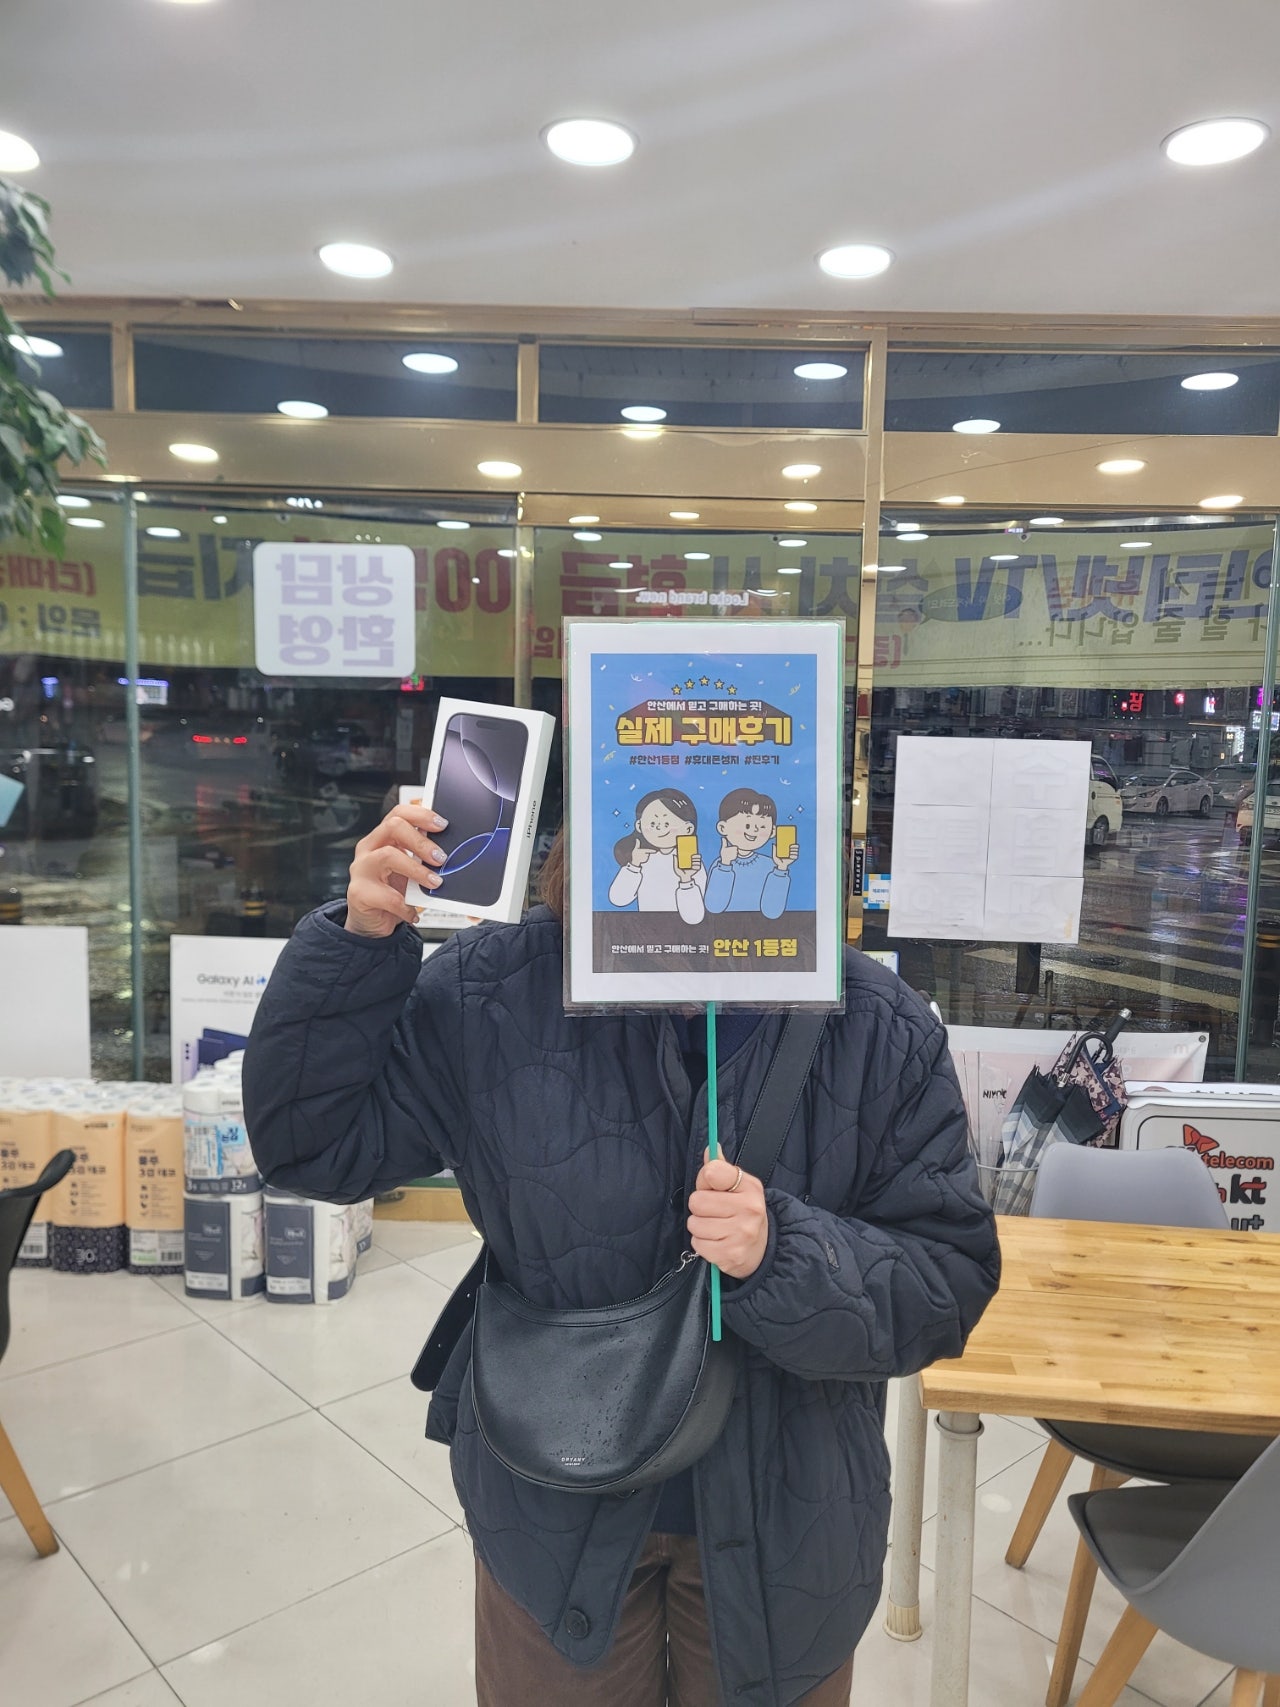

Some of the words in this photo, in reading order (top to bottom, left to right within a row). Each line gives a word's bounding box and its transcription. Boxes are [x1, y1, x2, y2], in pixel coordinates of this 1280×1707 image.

[647, 701, 686, 711] 안산에서
[688, 701, 707, 711] 믿고
[708, 701, 748, 711] 구매하는
[749, 701, 762, 711] 곳!
[616, 716, 674, 746] 실제
[680, 715, 792, 746] 구매후기
[526, 799, 538, 839] iPhone
[611, 944, 645, 954] 안산에서
[646, 944, 662, 954] 믿고
[664, 944, 697, 954] 구매하는
[713, 938, 750, 957] 안산
[753, 938, 798, 957] 1등점
[196, 973, 240, 988] Galaxy
[243, 974, 254, 985] AI
[1201, 1151, 1274, 1170] telecom
[1230, 1174, 1267, 1205] kt
